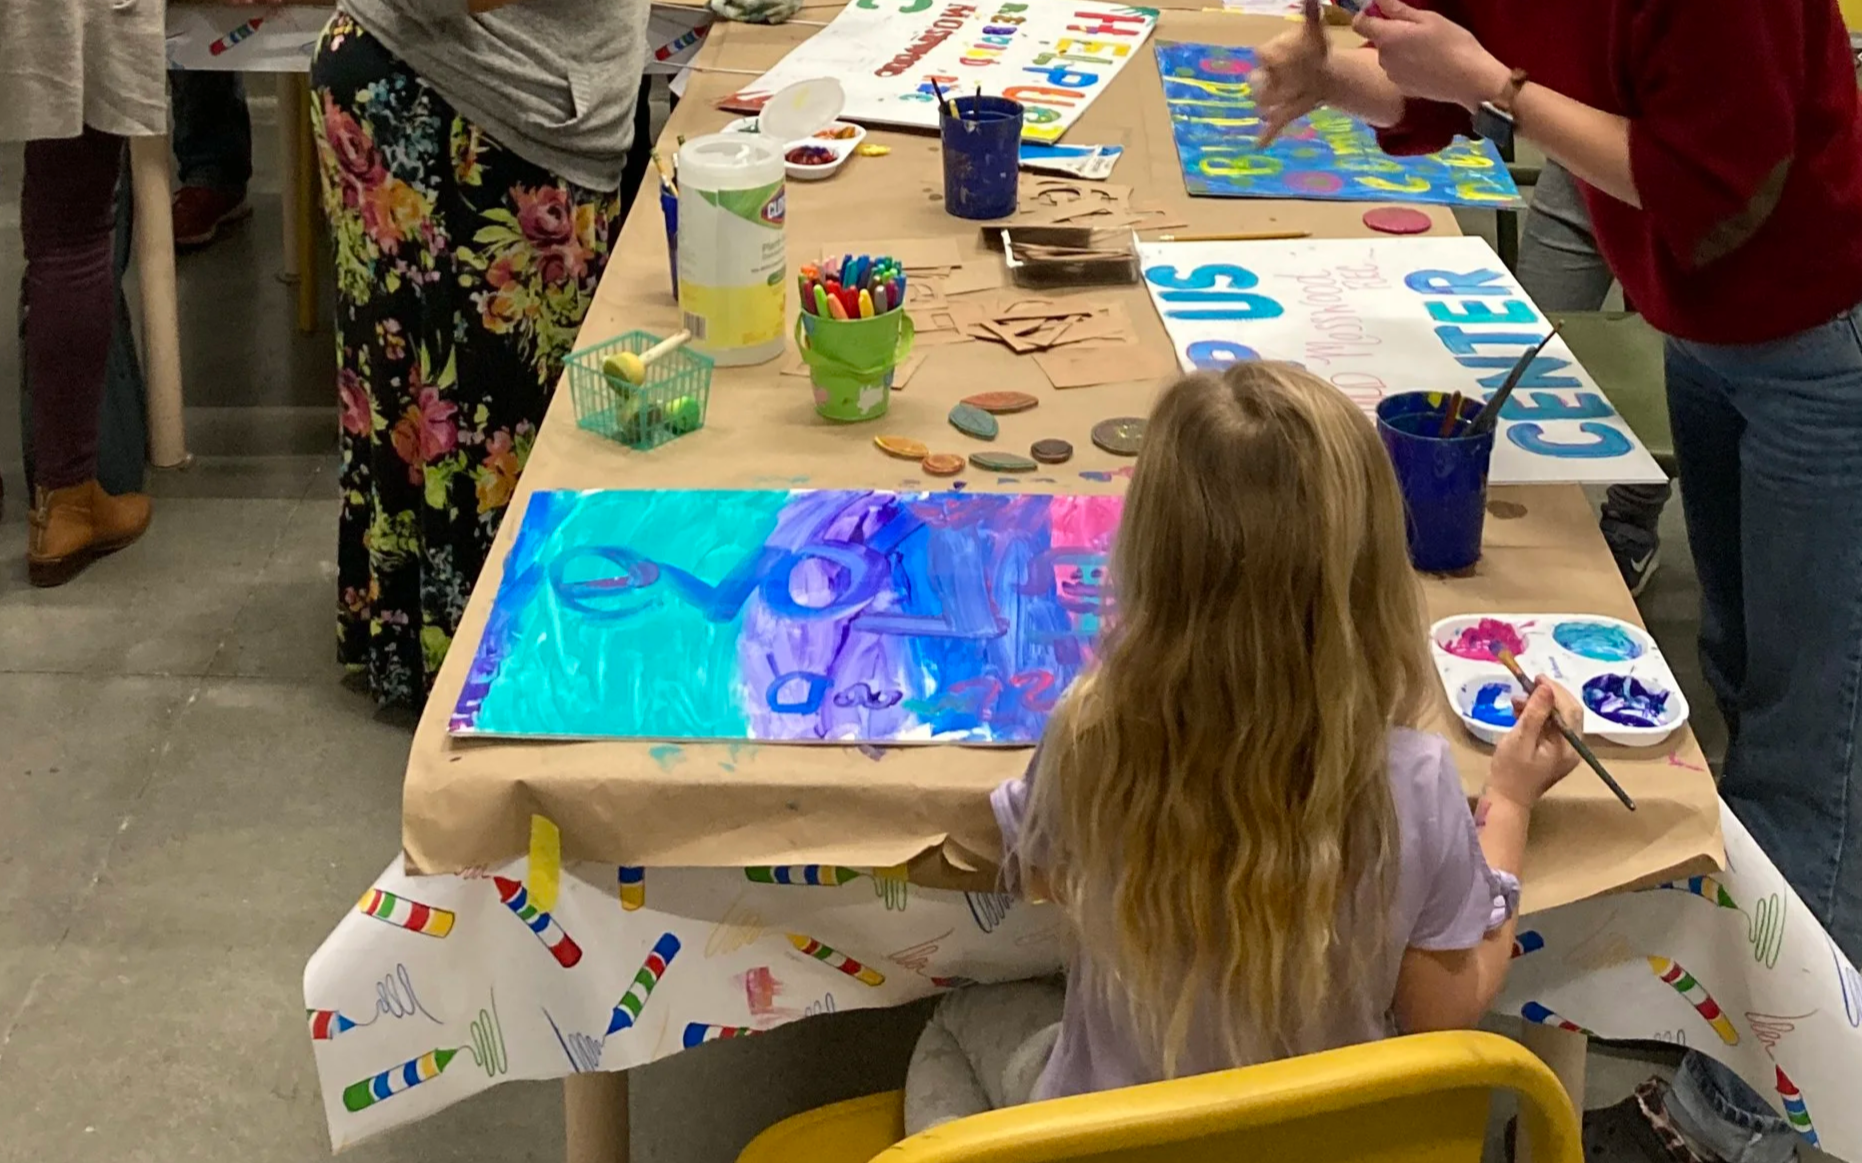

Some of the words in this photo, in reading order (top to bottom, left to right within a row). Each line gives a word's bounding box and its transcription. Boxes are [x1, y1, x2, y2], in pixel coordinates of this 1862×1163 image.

[1023, 10, 1146, 88] HELP
[1144, 263, 1285, 320] US
[1404, 268, 1634, 459] CENTER
